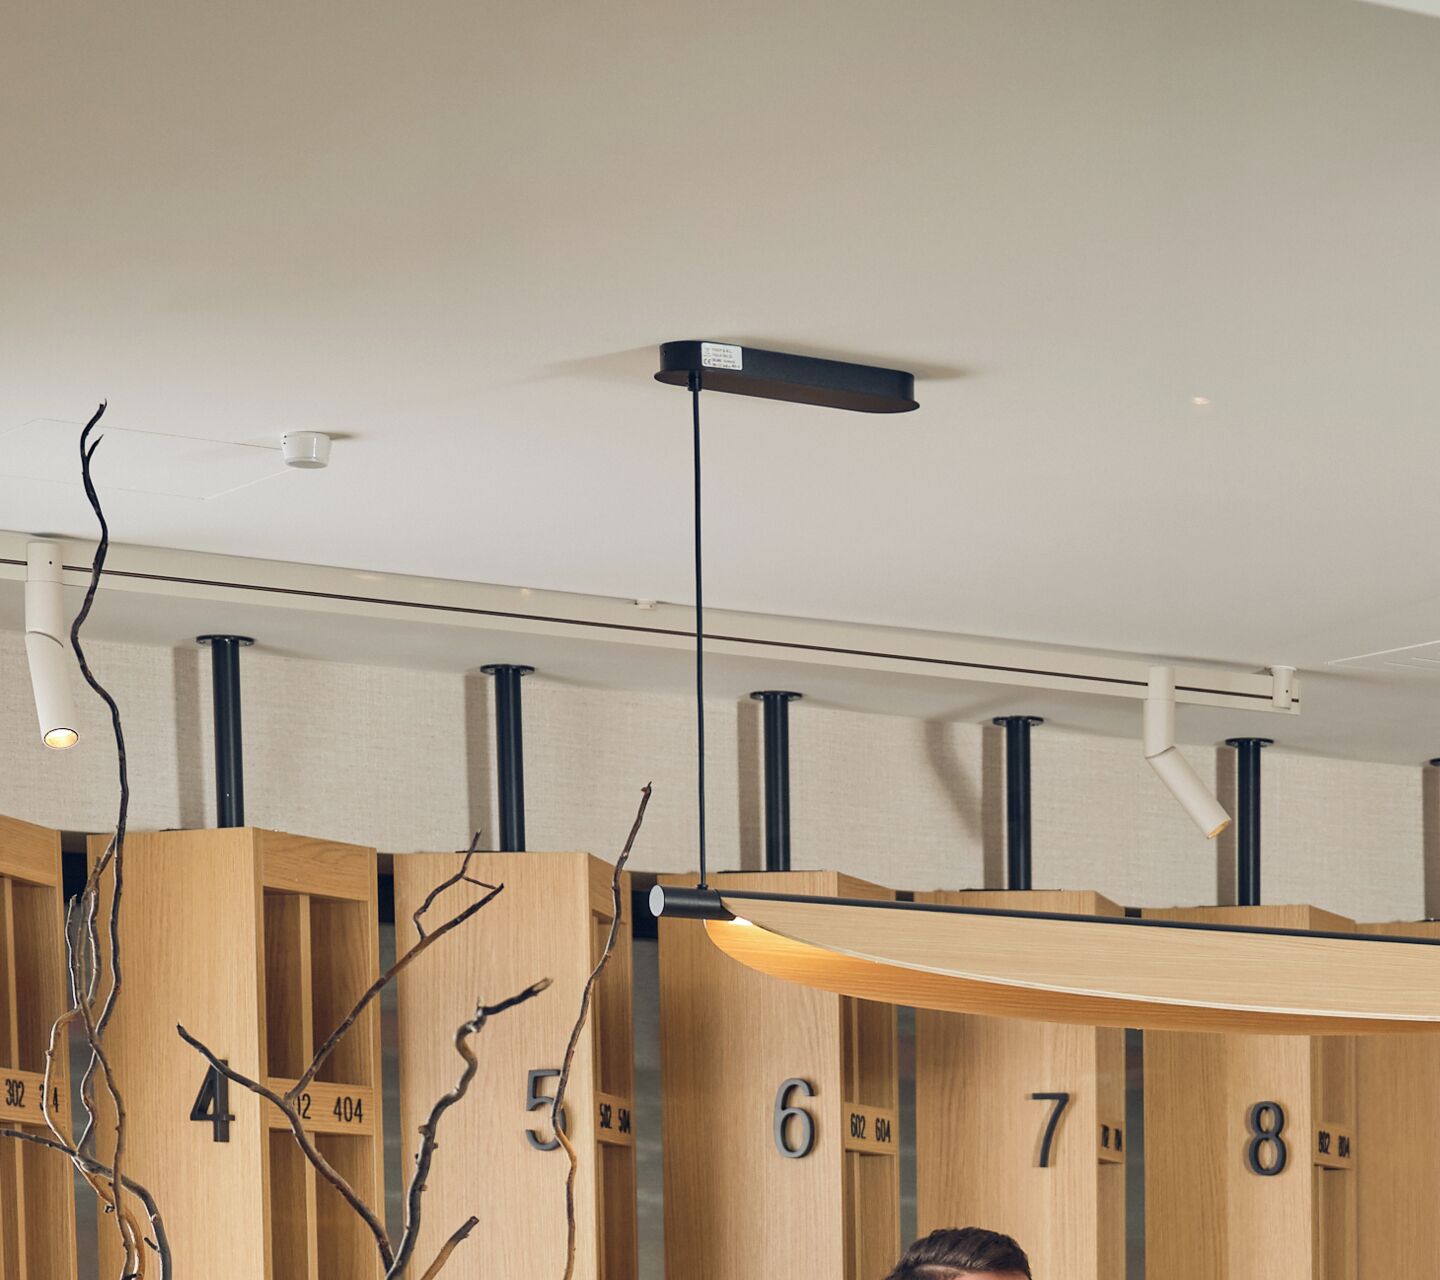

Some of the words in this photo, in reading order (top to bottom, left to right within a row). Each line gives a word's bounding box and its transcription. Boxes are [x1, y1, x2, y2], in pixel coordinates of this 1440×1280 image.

[5, 1078, 25, 1108] 302
[39, 1083, 59, 1113] 34
[190, 1059, 235, 1142] 4
[333, 1096, 363, 1123] 404
[526, 1069, 567, 1152] 5
[773, 1077, 816, 1159] 6
[850, 1113, 866, 1139] 602
[875, 1117, 891, 1143] 604
[1031, 1092, 1069, 1168] 7
[1248, 1100, 1287, 1176] 8
